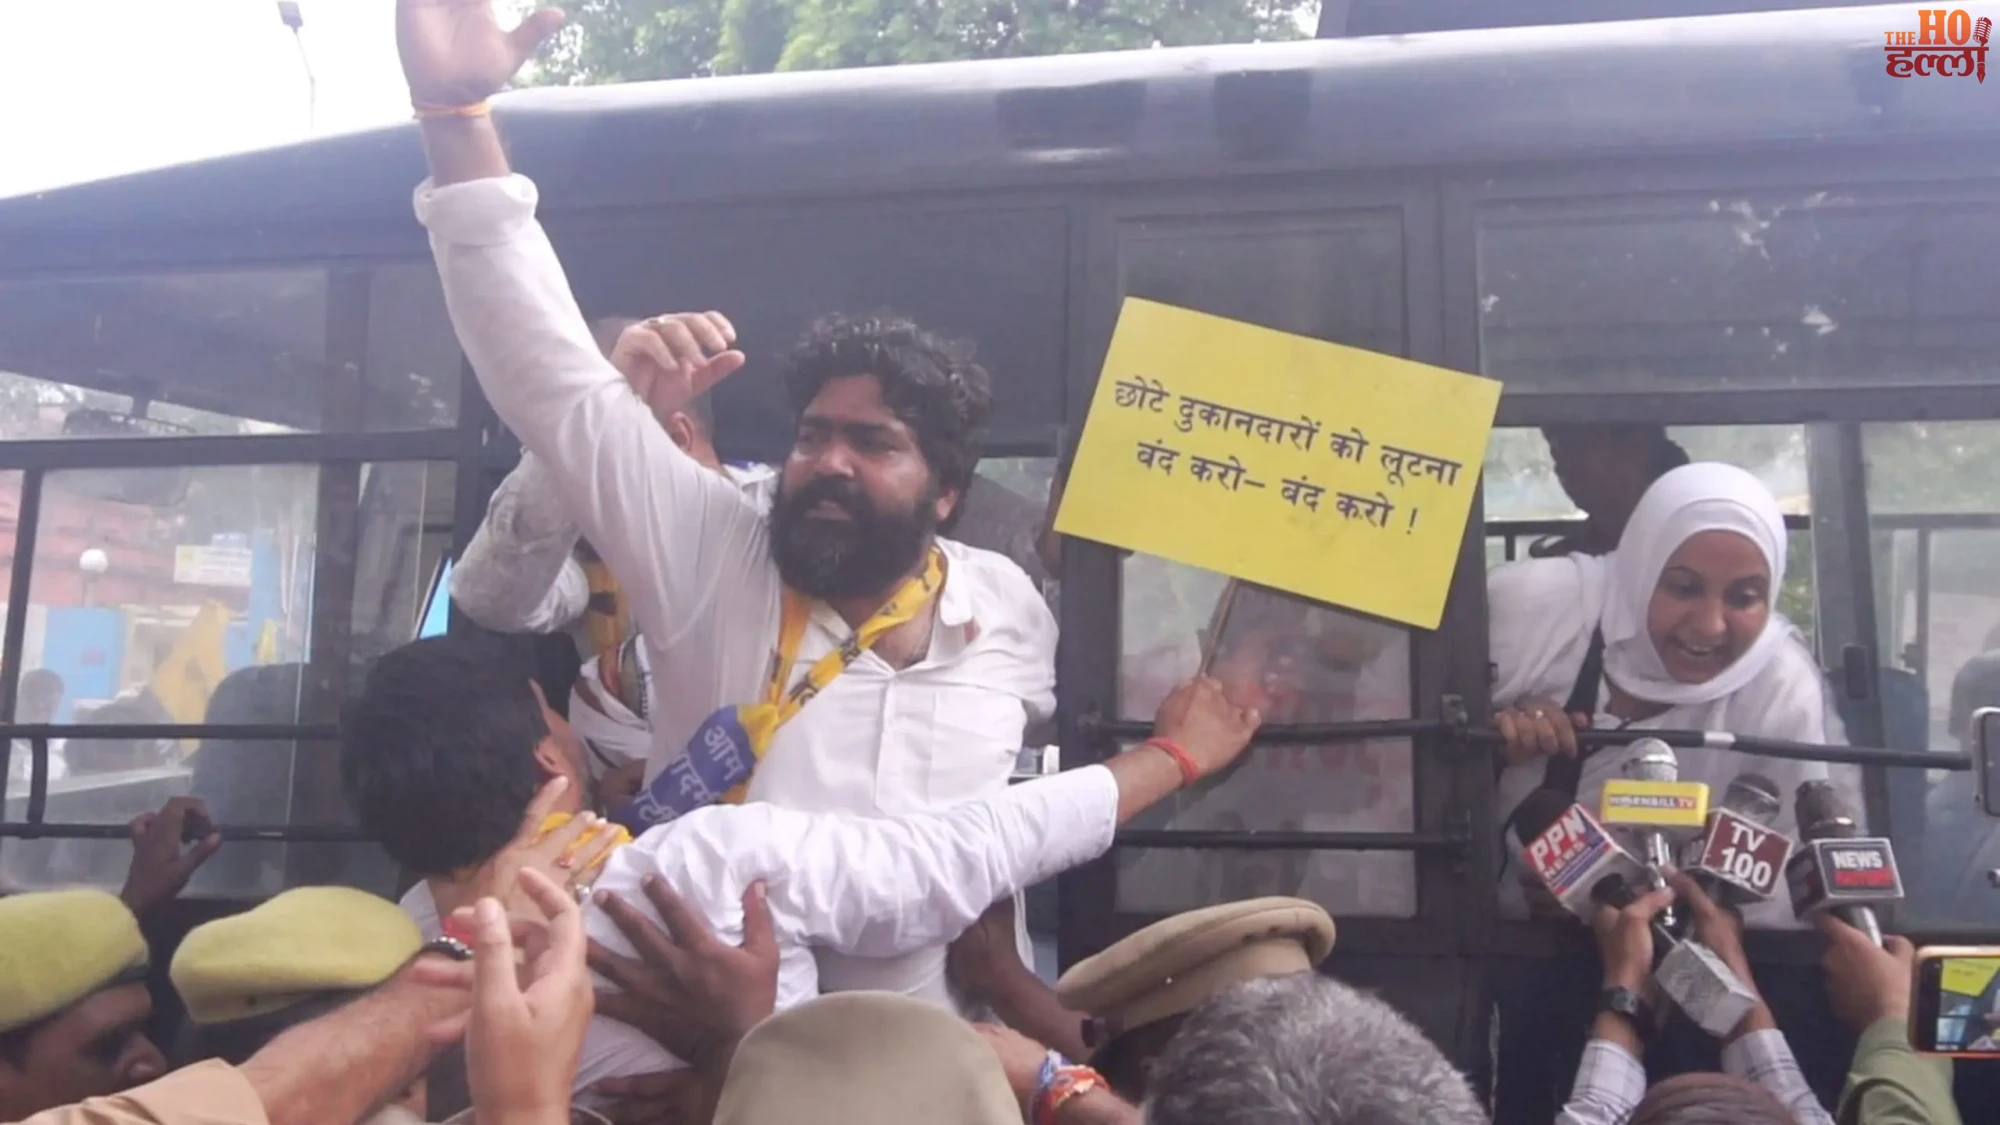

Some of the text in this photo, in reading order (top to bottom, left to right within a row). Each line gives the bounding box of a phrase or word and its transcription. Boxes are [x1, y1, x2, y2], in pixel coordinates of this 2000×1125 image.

[1115, 374, 1463, 487] छोटे दुकानदारों को लूटना
[1336, 491, 1395, 528] करो
[704, 725, 746, 782] आम
[1529, 806, 1586, 873] PPN
[1730, 820, 1766, 852] TV
[1720, 846, 1772, 888] 100
[1831, 850, 1883, 870] NEWS
